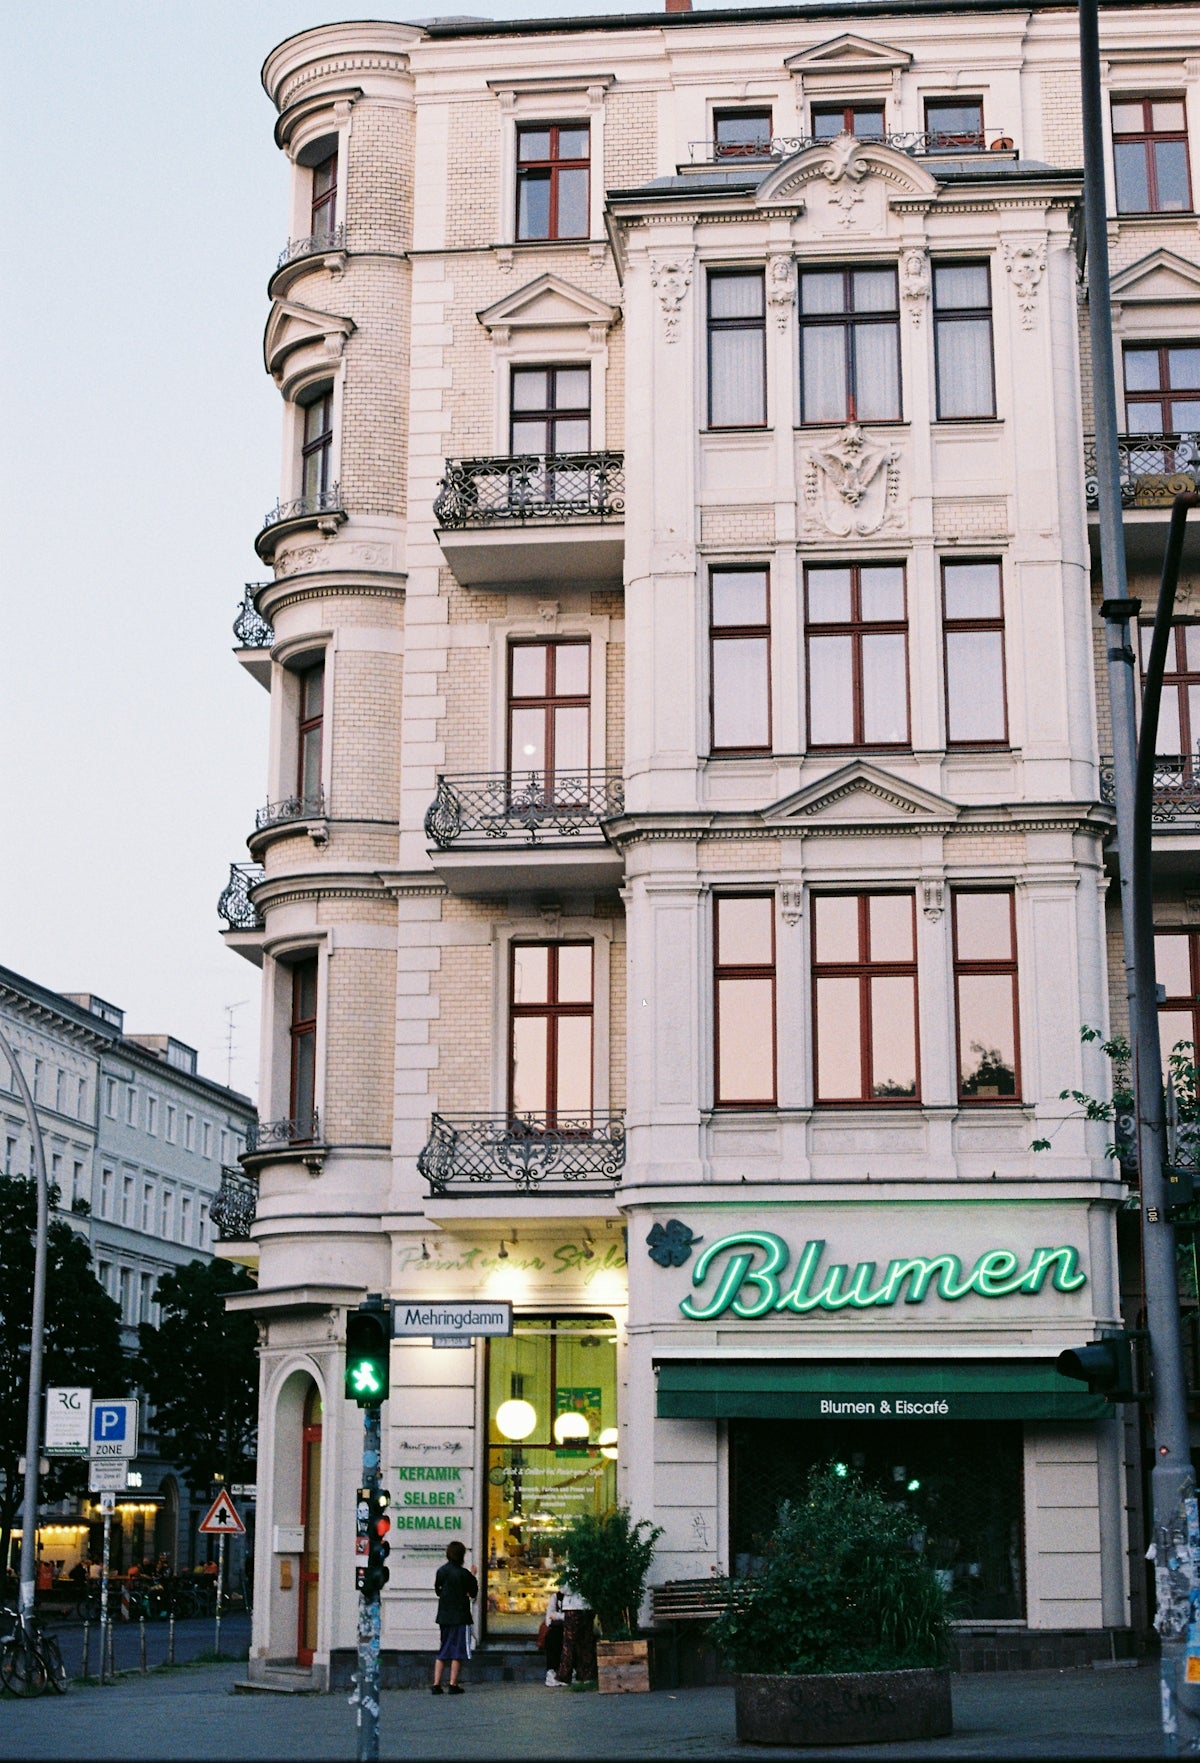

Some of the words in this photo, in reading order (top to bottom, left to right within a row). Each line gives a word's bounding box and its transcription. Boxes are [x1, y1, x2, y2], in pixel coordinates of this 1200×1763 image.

[553, 1244, 627, 1286] Style
[680, 1231, 1087, 1320] Blumen
[404, 1308, 504, 1330] Mehringdamm
[58, 1392, 81, 1410] RG
[820, 1399, 875, 1414] Blumen
[879, 1400, 892, 1415] &
[895, 1399, 949, 1415] Eiscafé
[101, 1410, 119, 1437] P
[96, 1444, 123, 1455] ZONE
[399, 1466, 462, 1481] KERAMIK
[403, 1491, 455, 1505] SELBER
[396, 1515, 462, 1530] BEMALEN
